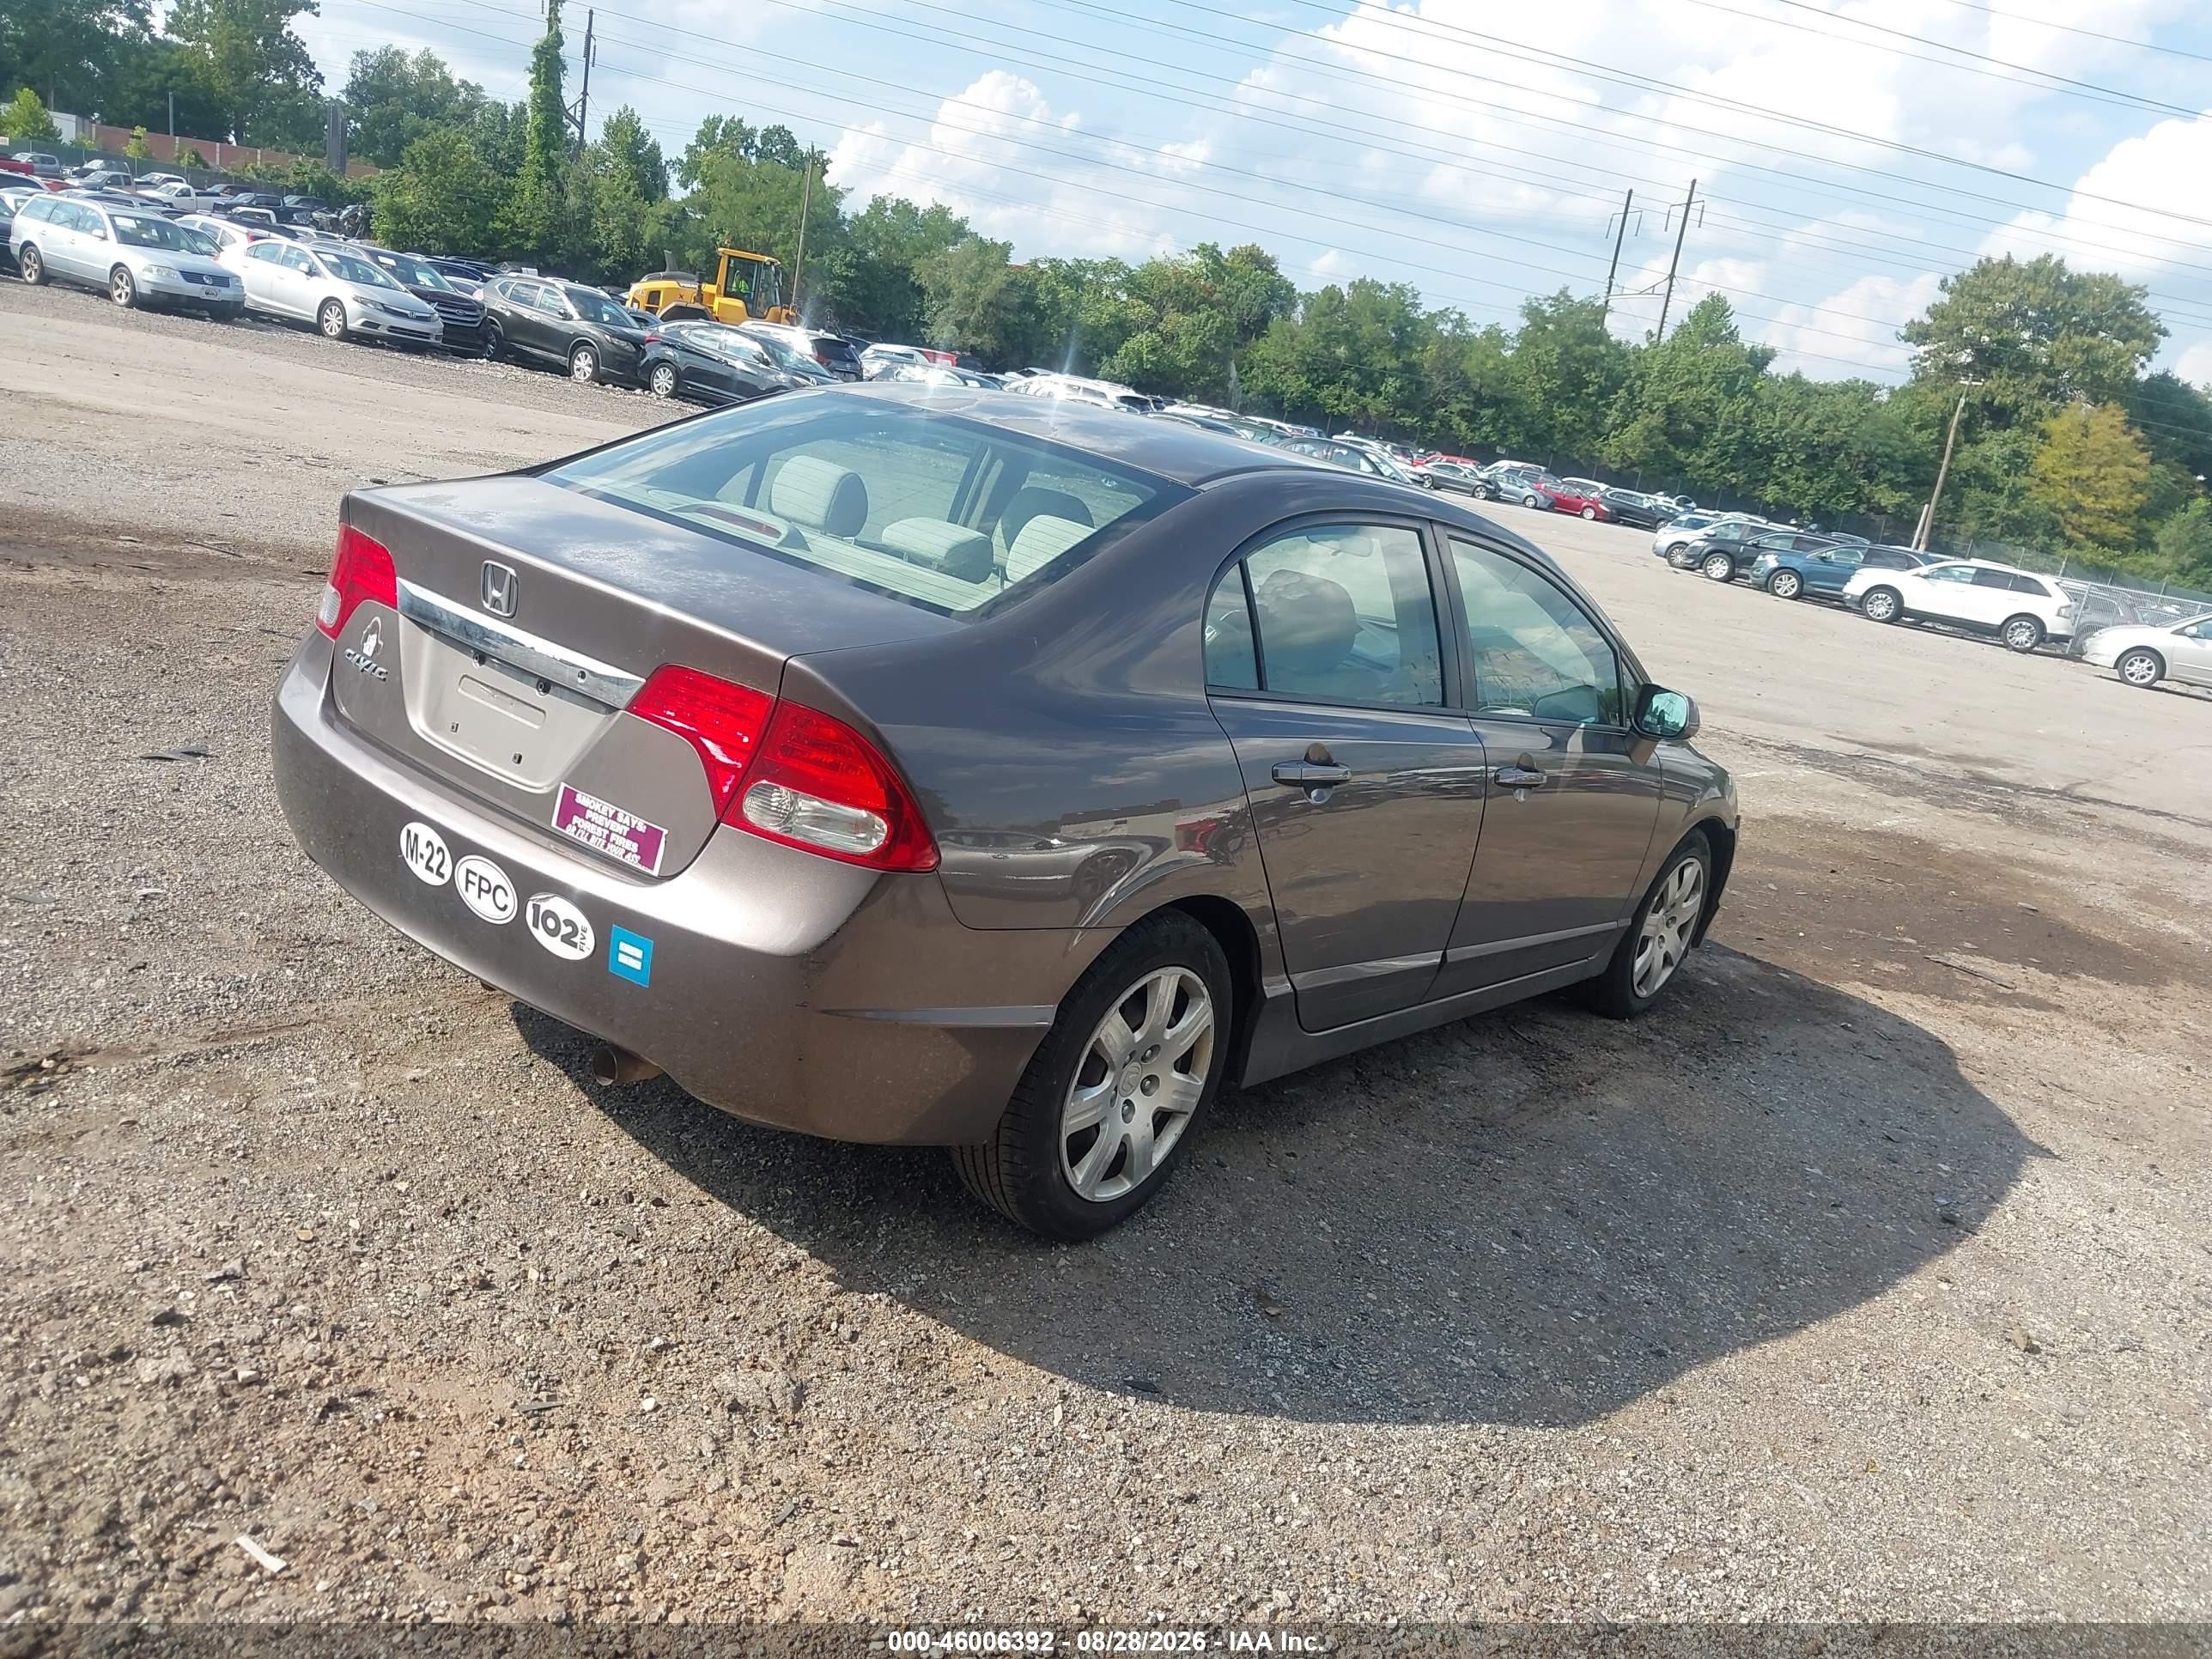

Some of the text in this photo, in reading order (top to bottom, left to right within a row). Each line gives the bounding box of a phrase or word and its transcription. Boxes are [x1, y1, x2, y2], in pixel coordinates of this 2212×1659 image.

[344, 648, 388, 682] CIVIC
[574, 793, 617, 819] SMOKEY
[585, 809, 630, 836] PREVENT
[565, 823, 578, 836] OR
[588, 836, 607, 849] BITE
[605, 842, 627, 858] YOUR
[572, 814, 639, 854] FOREST FIRES
[405, 828, 447, 880] M-22
[465, 867, 509, 912] FPC
[531, 902, 580, 950] 102
[579, 924, 589, 952] FIVE
